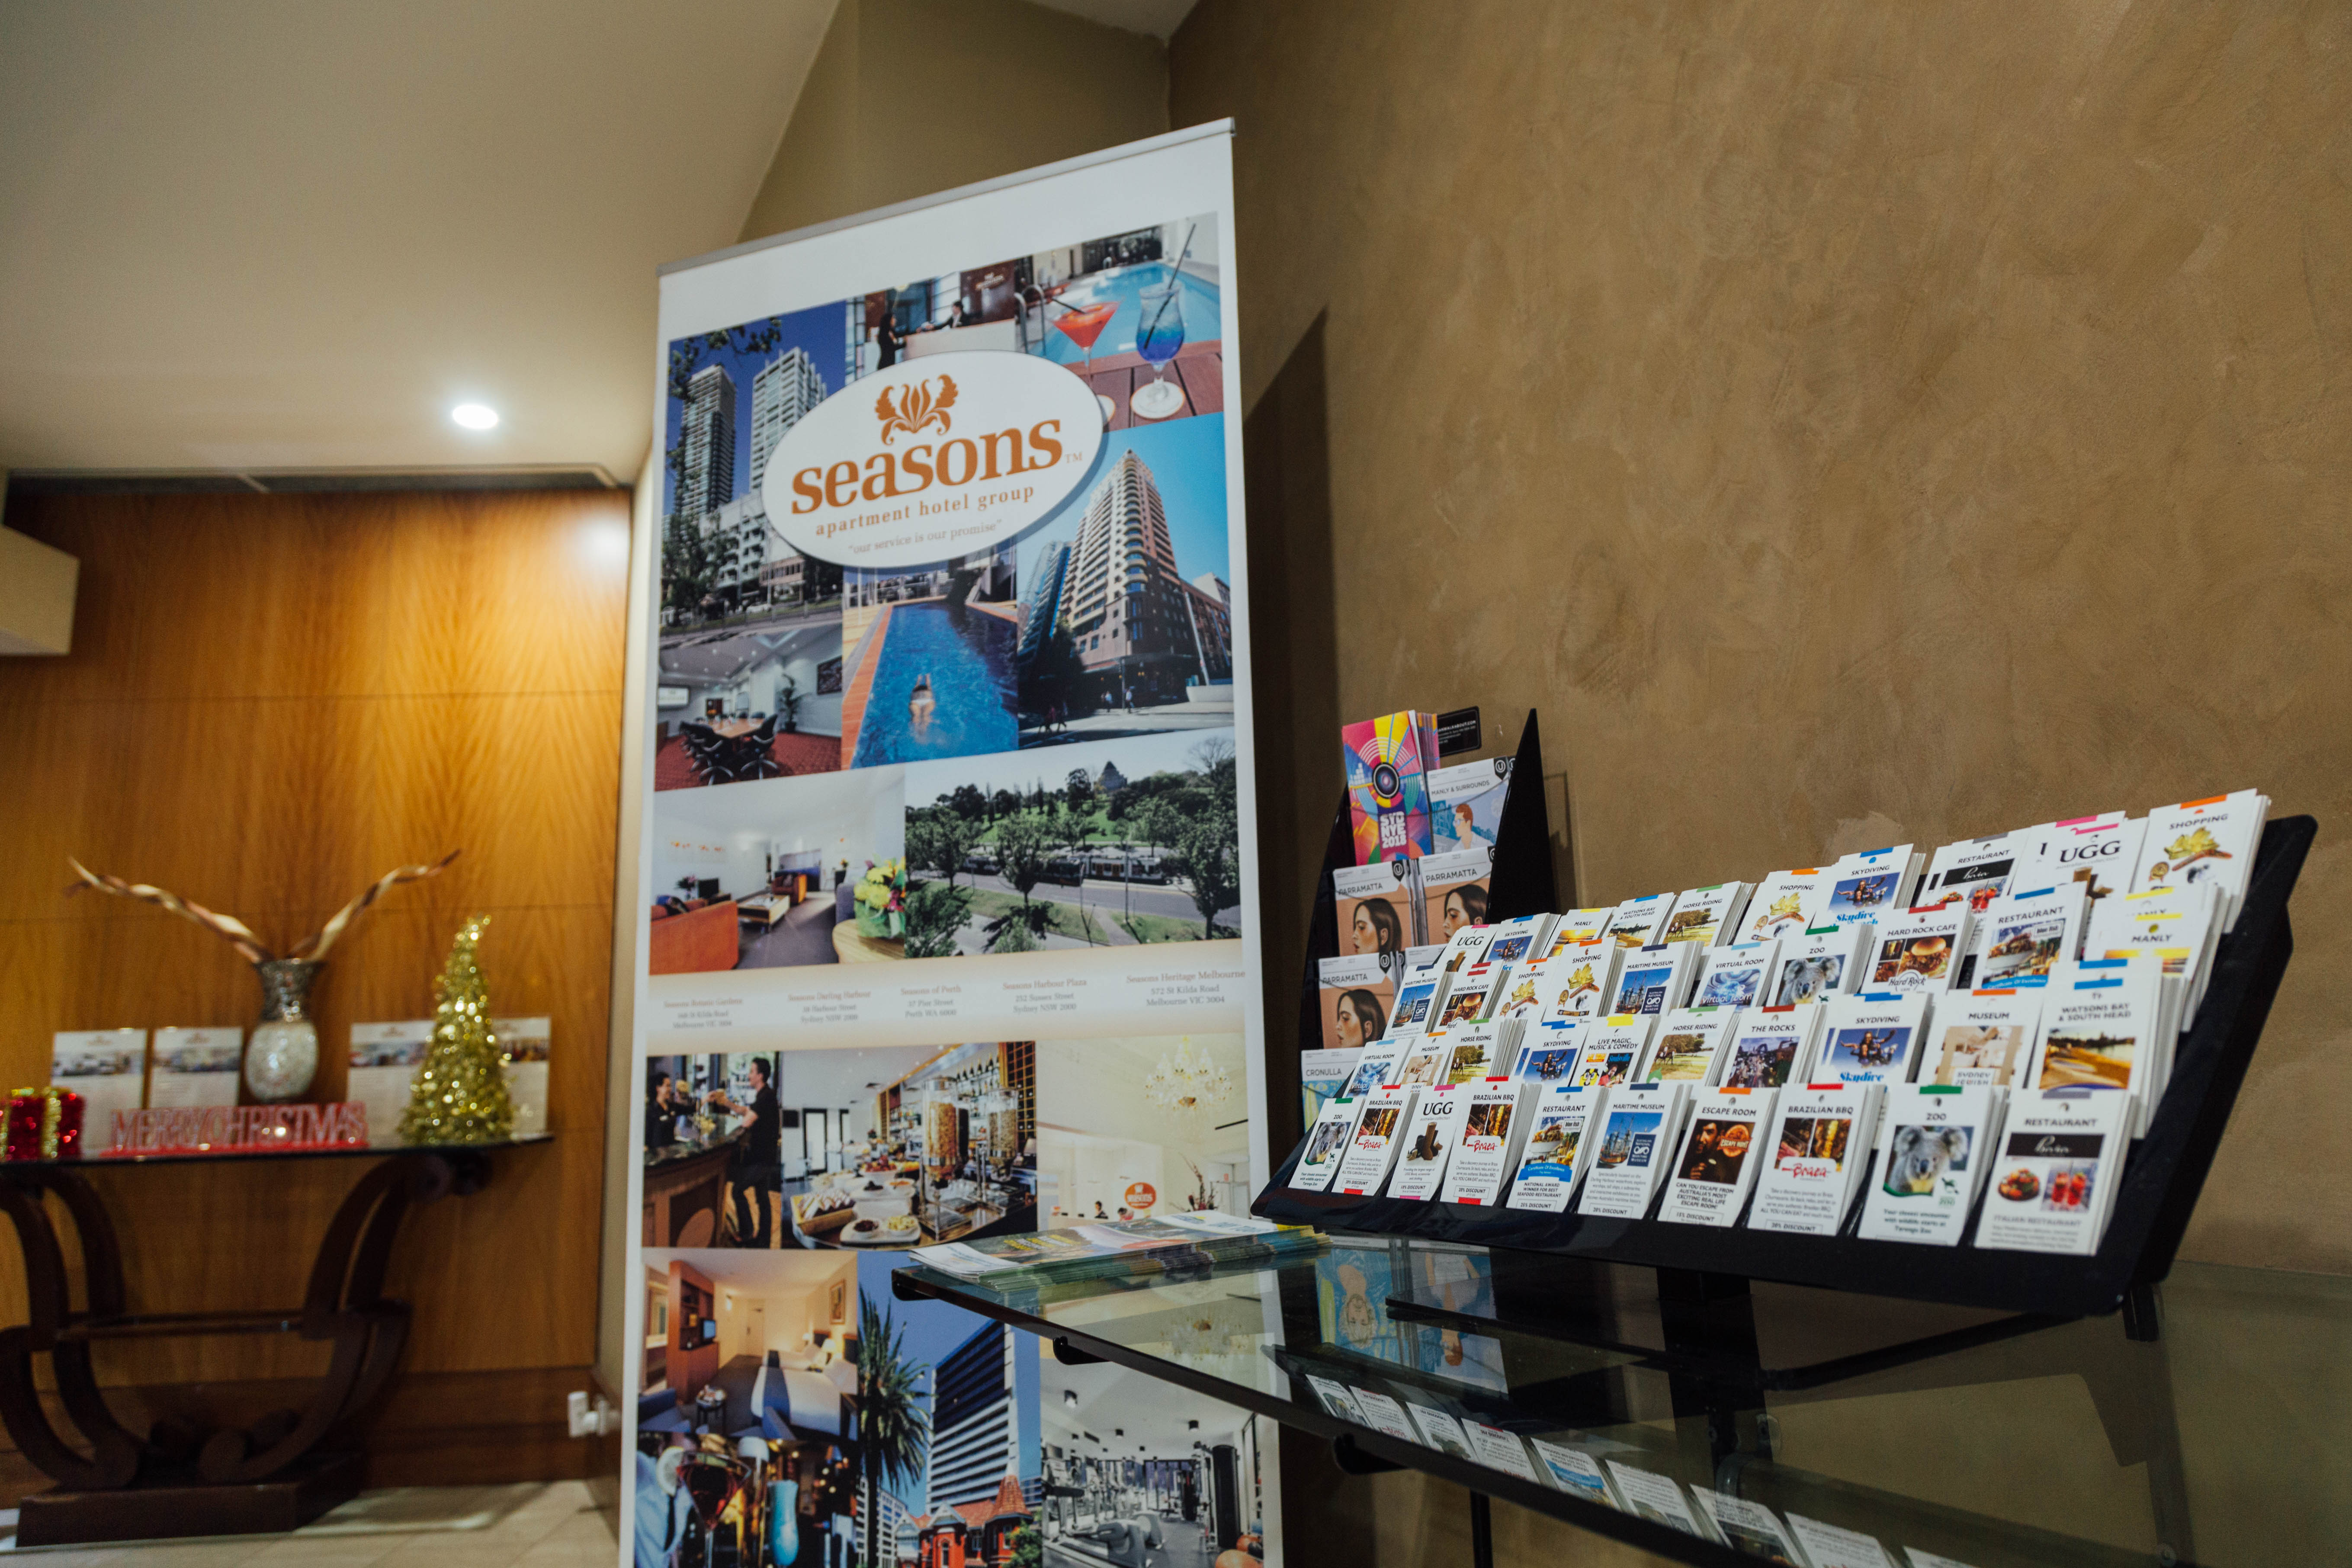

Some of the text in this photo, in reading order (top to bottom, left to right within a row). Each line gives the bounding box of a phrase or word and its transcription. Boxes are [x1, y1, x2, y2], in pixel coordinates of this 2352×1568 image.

[792, 419, 1063, 514] seasons
[815, 485, 1034, 538] apartment hotel group
[874, 535, 911, 550] service
[915, 532, 924, 543] is
[927, 529, 946, 541] our
[1456, 780, 1489, 791] SURROUNDS
[1380, 811, 1404, 825] SYD
[2170, 814, 2228, 830] SHOPPING
[1381, 822, 1406, 838] NYE
[1382, 834, 1406, 849] 2018
[1958, 850, 2010, 864] RESTAURANT
[2060, 840, 2121, 863] UGG
[1426, 869, 1477, 882] PARRAMATTA
[1851, 865, 1890, 875] SKYDIVING
[1339, 882, 1382, 895] PARRAMATTA
[1998, 906, 2064, 924] RESTAURANT
[1457, 936, 1484, 946] UGG
[2132, 934, 2172, 943] MANLY
[1572, 955, 1601, 964] SHOPPING
[1716, 960, 1742, 968] VIRTUAL
[1126, 970, 1245, 983] Seasons Heritage Melbourne
[1322, 973, 1367, 984] PARRAMATTA
[1889, 977, 1926, 986] Hard Rock
[1306, 1068, 1341, 1077] CRONULLA
[1423, 1102, 1453, 1116] UGG
[1835, 1106, 1853, 1115] BBQ
[2024, 1119, 2098, 1127] RESTAURANT
[1687, 1213, 1714, 1222] DISCOUNT
